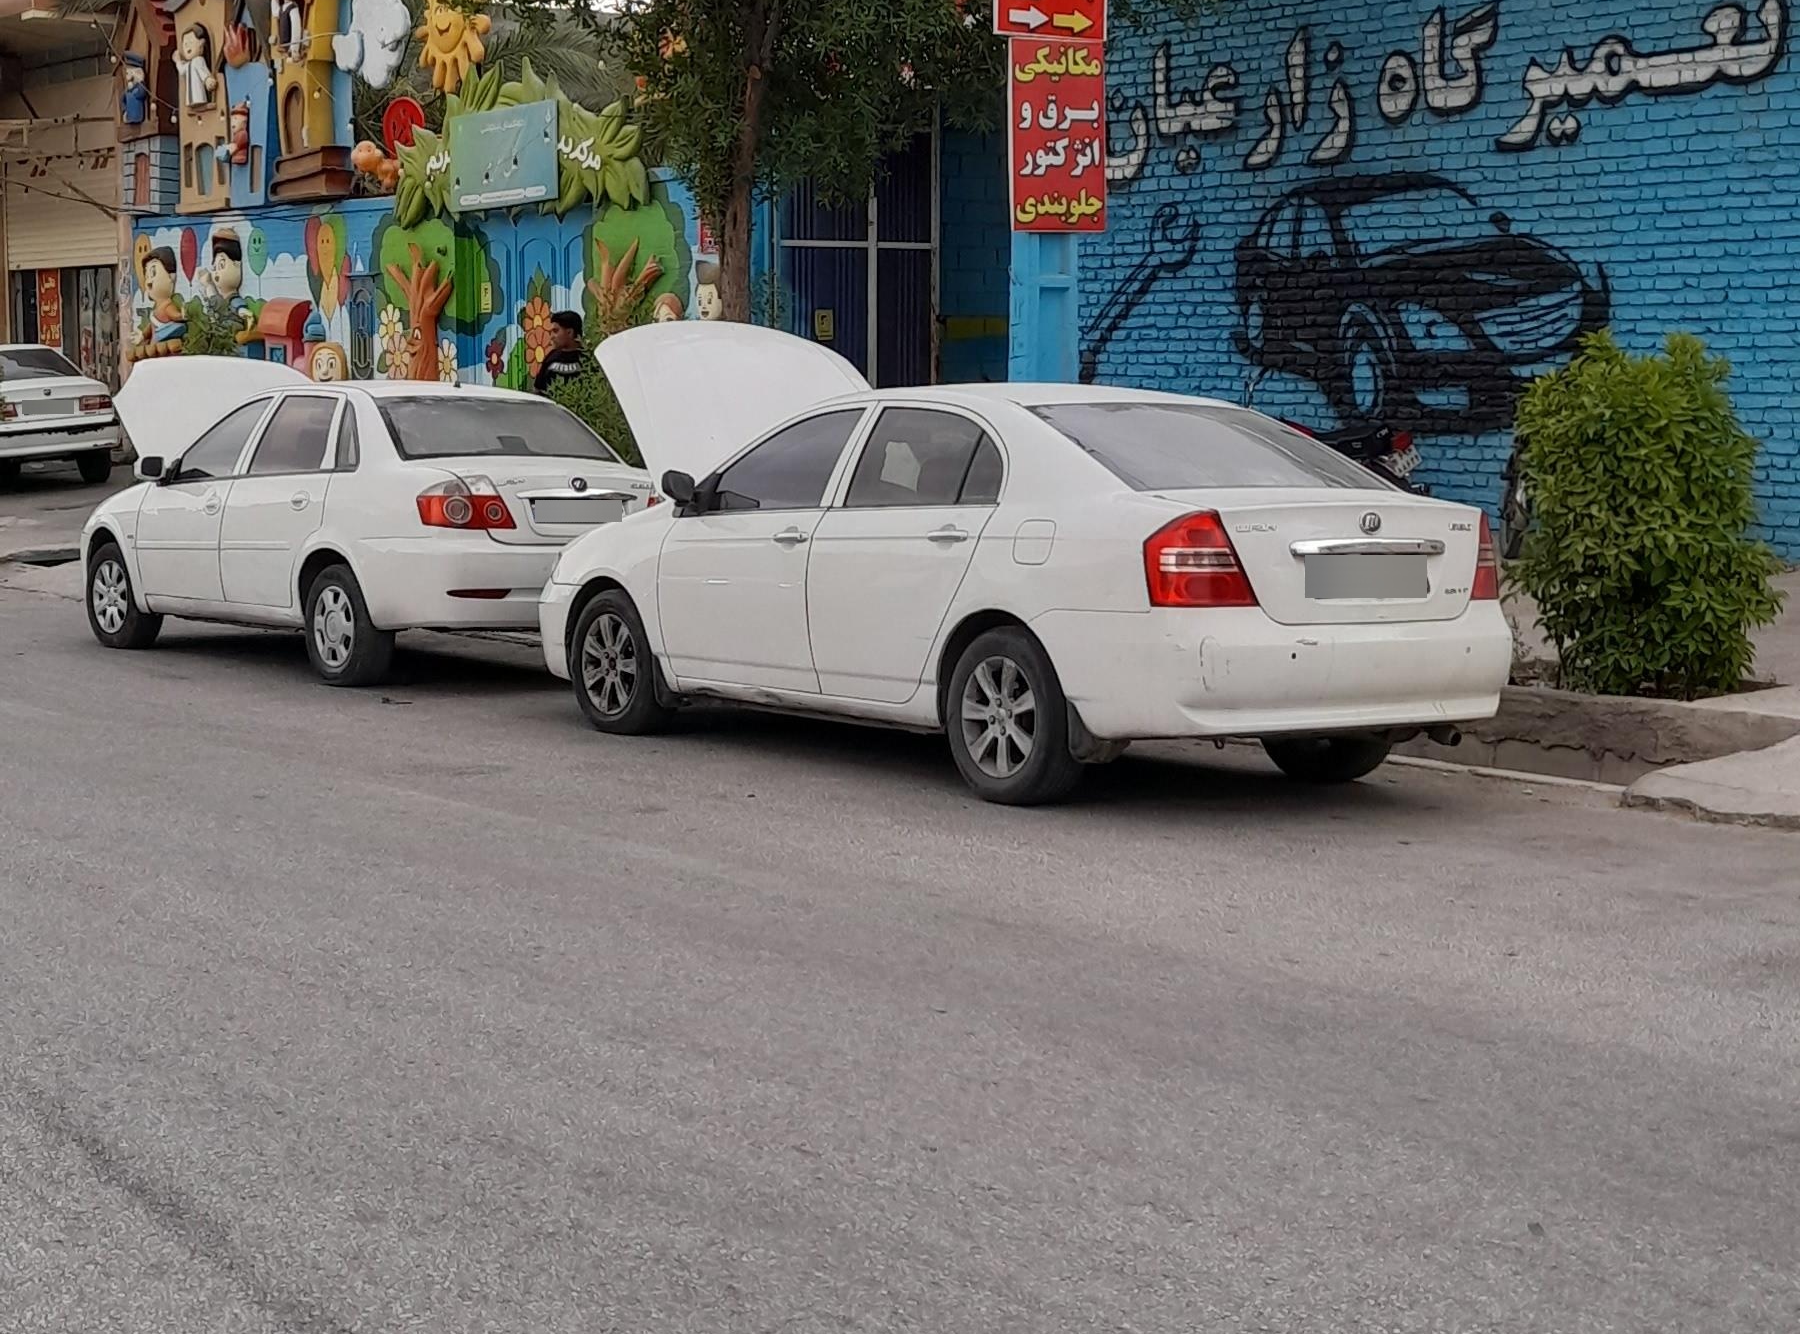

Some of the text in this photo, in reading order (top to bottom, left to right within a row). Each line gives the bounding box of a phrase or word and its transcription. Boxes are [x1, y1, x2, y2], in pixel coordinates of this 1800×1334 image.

[1014, 46, 1102, 82] مکانیکی
[1018, 95, 1099, 130] برق و
[1015, 188, 1103, 224] جلوبندی
